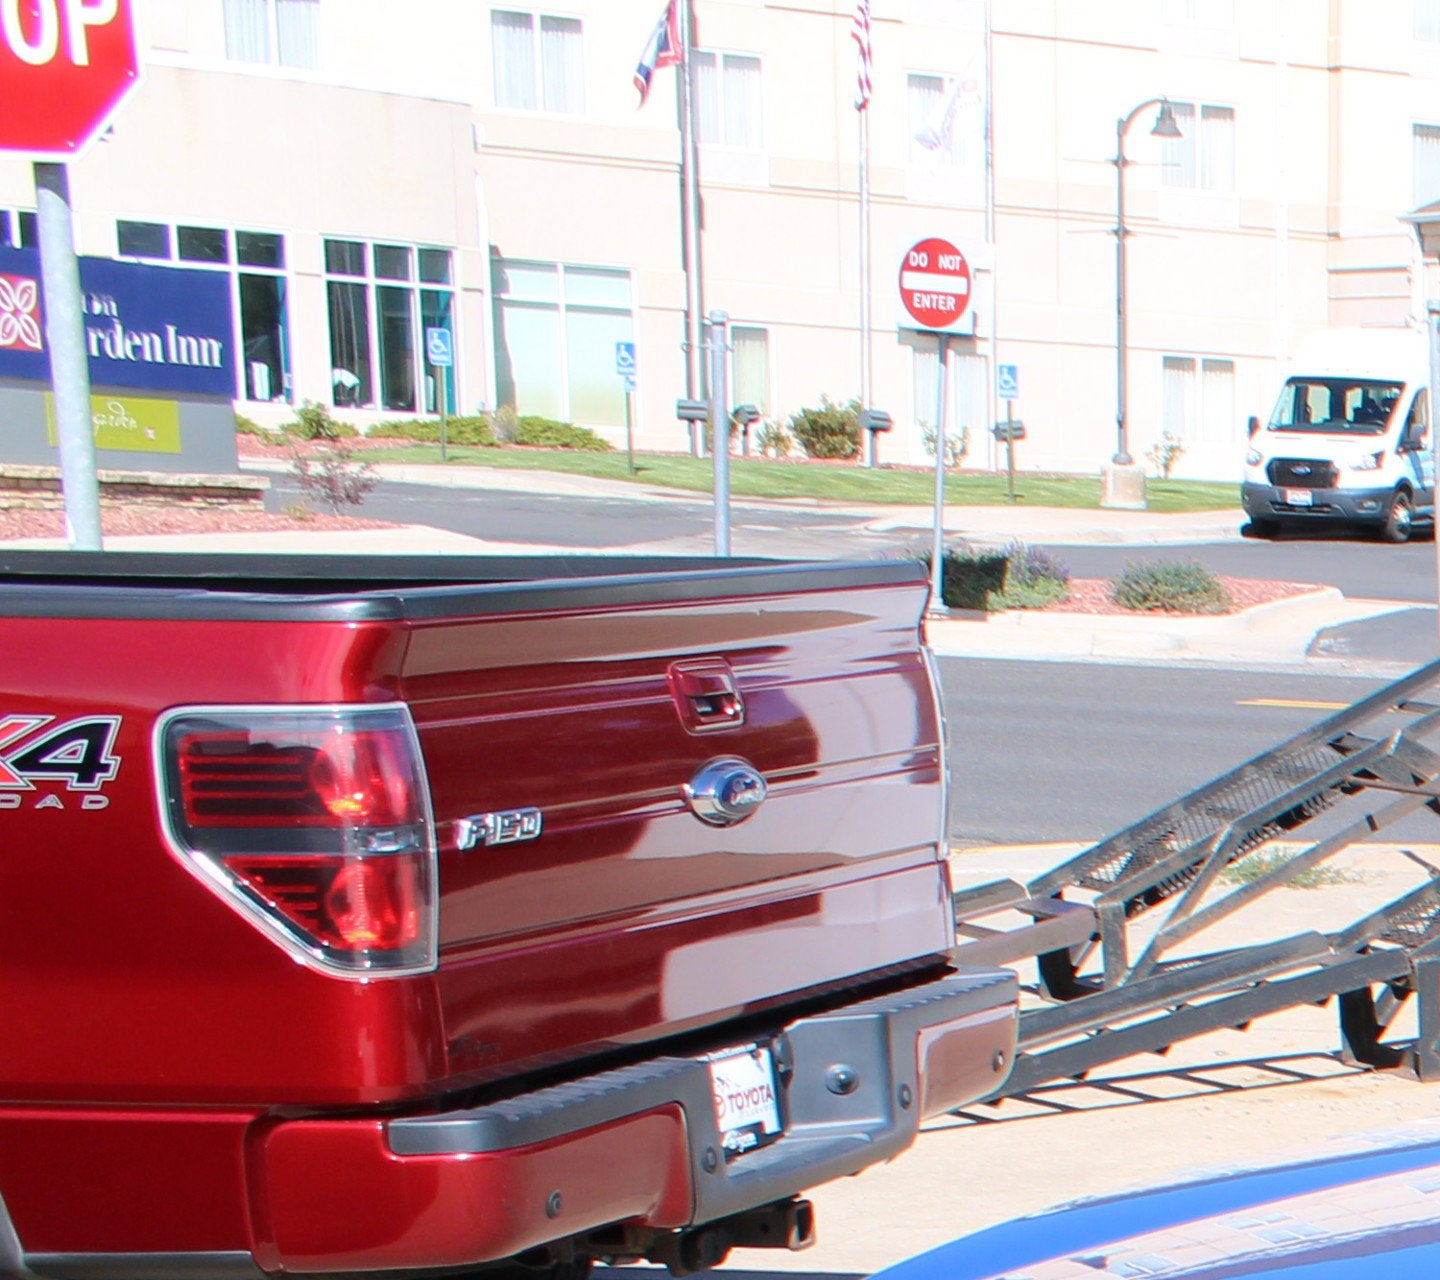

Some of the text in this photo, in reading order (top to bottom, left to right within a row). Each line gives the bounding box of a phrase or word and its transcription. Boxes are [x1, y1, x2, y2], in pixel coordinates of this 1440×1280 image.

[0, 0, 119, 66] OP
[908, 250, 963, 271] DO NOT
[913, 292, 956, 312] ENTER
[86, 317, 223, 369] rden Inn
[0, 714, 123, 791] X4
[0, 794, 110, 810] OAD
[728, 1083, 775, 1114] TOYOTA
